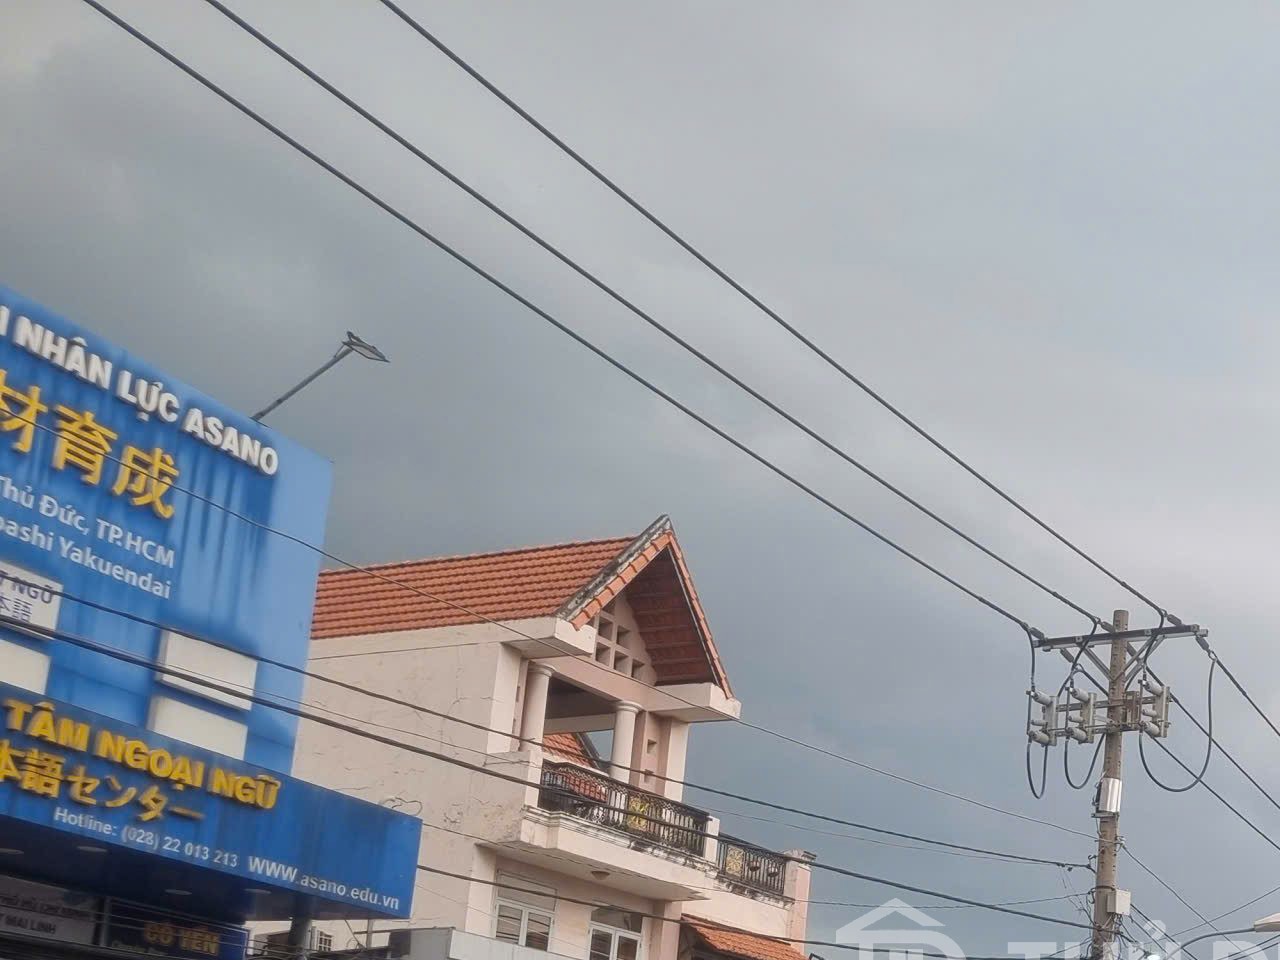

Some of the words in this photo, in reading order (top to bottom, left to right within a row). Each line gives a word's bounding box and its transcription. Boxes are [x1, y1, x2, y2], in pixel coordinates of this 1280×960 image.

[14, 315, 113, 390] NHÂN
[117, 369, 180, 422] LỰC
[183, 406, 280, 476] ASANO
[59, 535, 172, 600] Yakuendai
[96, 517, 176, 569] TP.HCM
[7, 700, 91, 752] TÂM
[97, 729, 205, 791] NGOẠI
[209, 766, 283, 810] NGỮ
[55, 806, 118, 838] Hotline:
[121, 824, 160, 852] (028)
[162, 834, 181, 853] 22
[185, 840, 210, 861] 013
[214, 847, 239, 869] 213
[247, 855, 401, 912] WWW.asano.edu.vn
